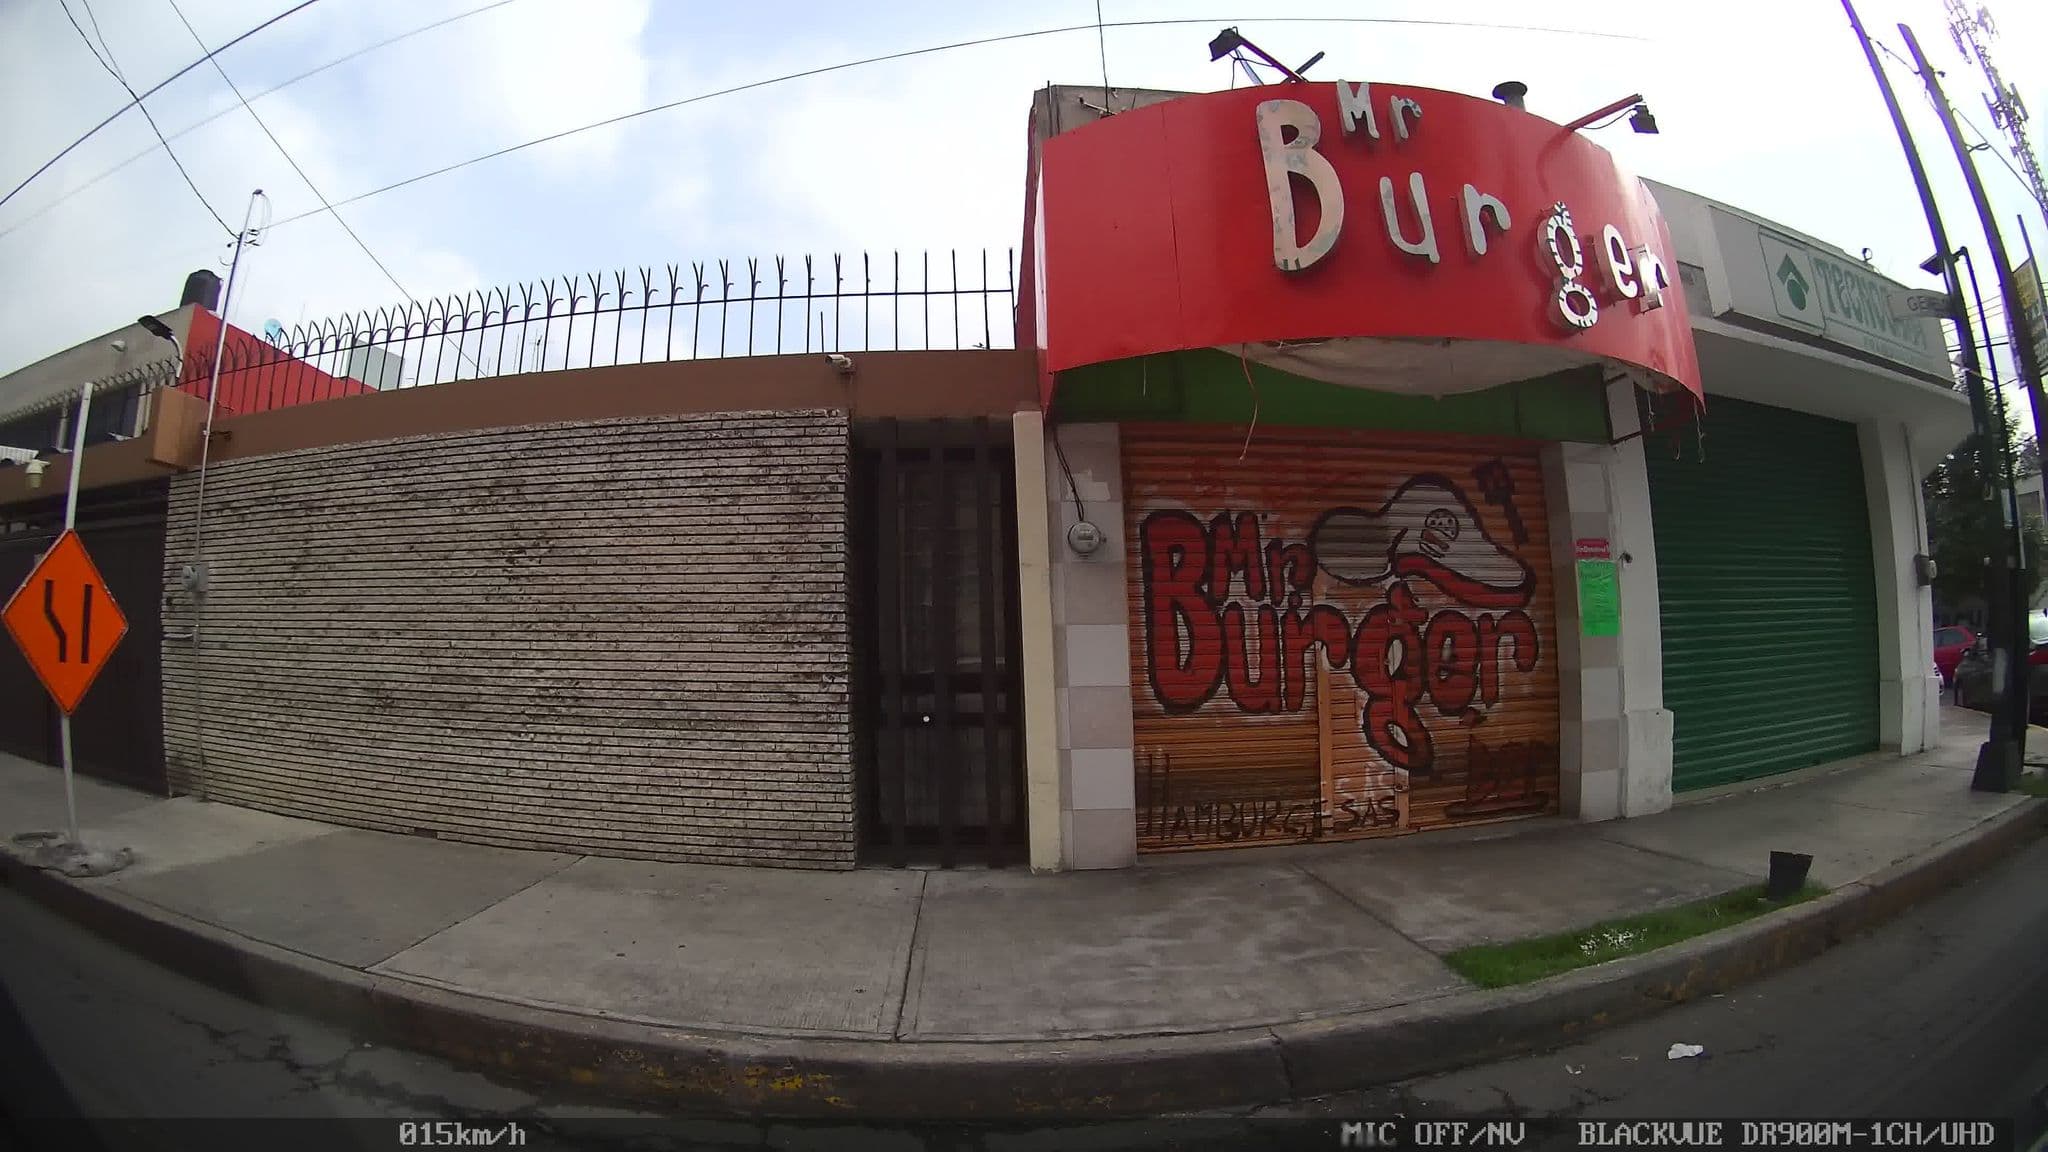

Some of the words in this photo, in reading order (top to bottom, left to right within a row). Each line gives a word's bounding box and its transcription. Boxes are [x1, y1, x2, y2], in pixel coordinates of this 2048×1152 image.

[1336, 79, 1423, 144] Mr
[1256, 98, 1670, 331] Burger
[1207, 509, 1313, 604] Mr
[1141, 508, 1539, 775] Burger
